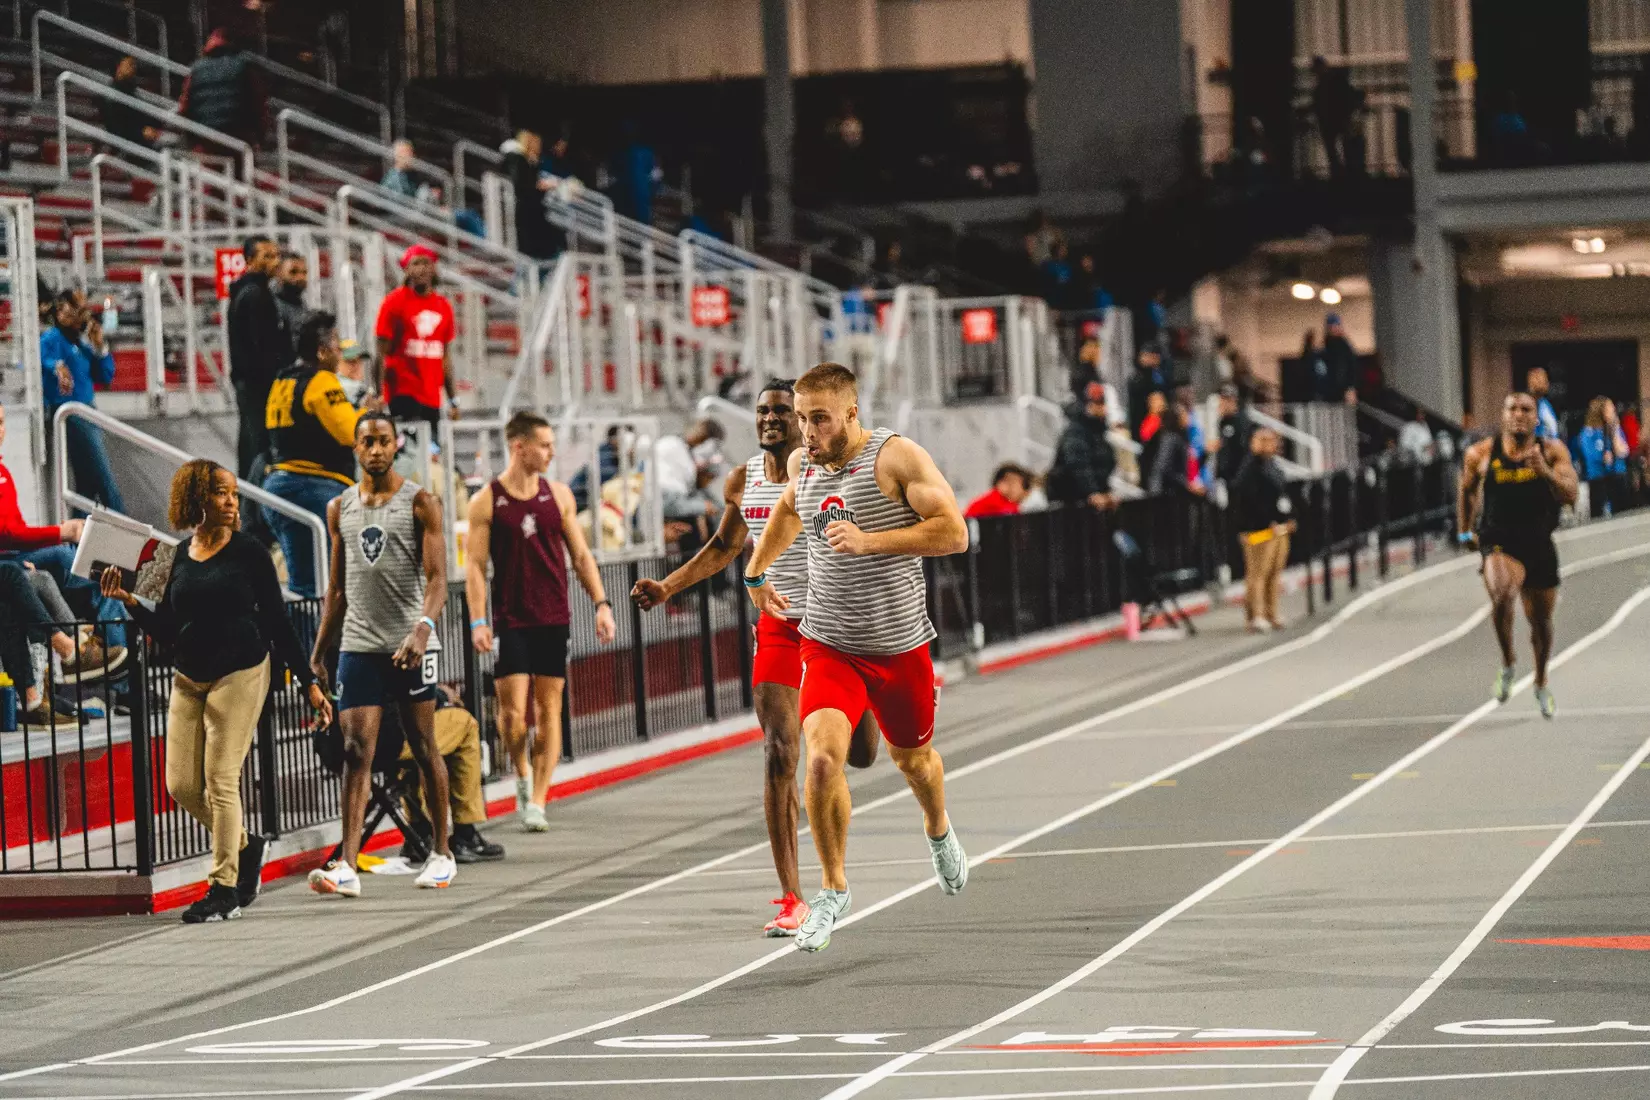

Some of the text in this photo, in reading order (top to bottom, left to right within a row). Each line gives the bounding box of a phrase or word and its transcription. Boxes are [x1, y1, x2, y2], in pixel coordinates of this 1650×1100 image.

[221, 253, 247, 273] 10
[425, 658, 434, 679] 5
[593, 1032, 905, 1049] 5
